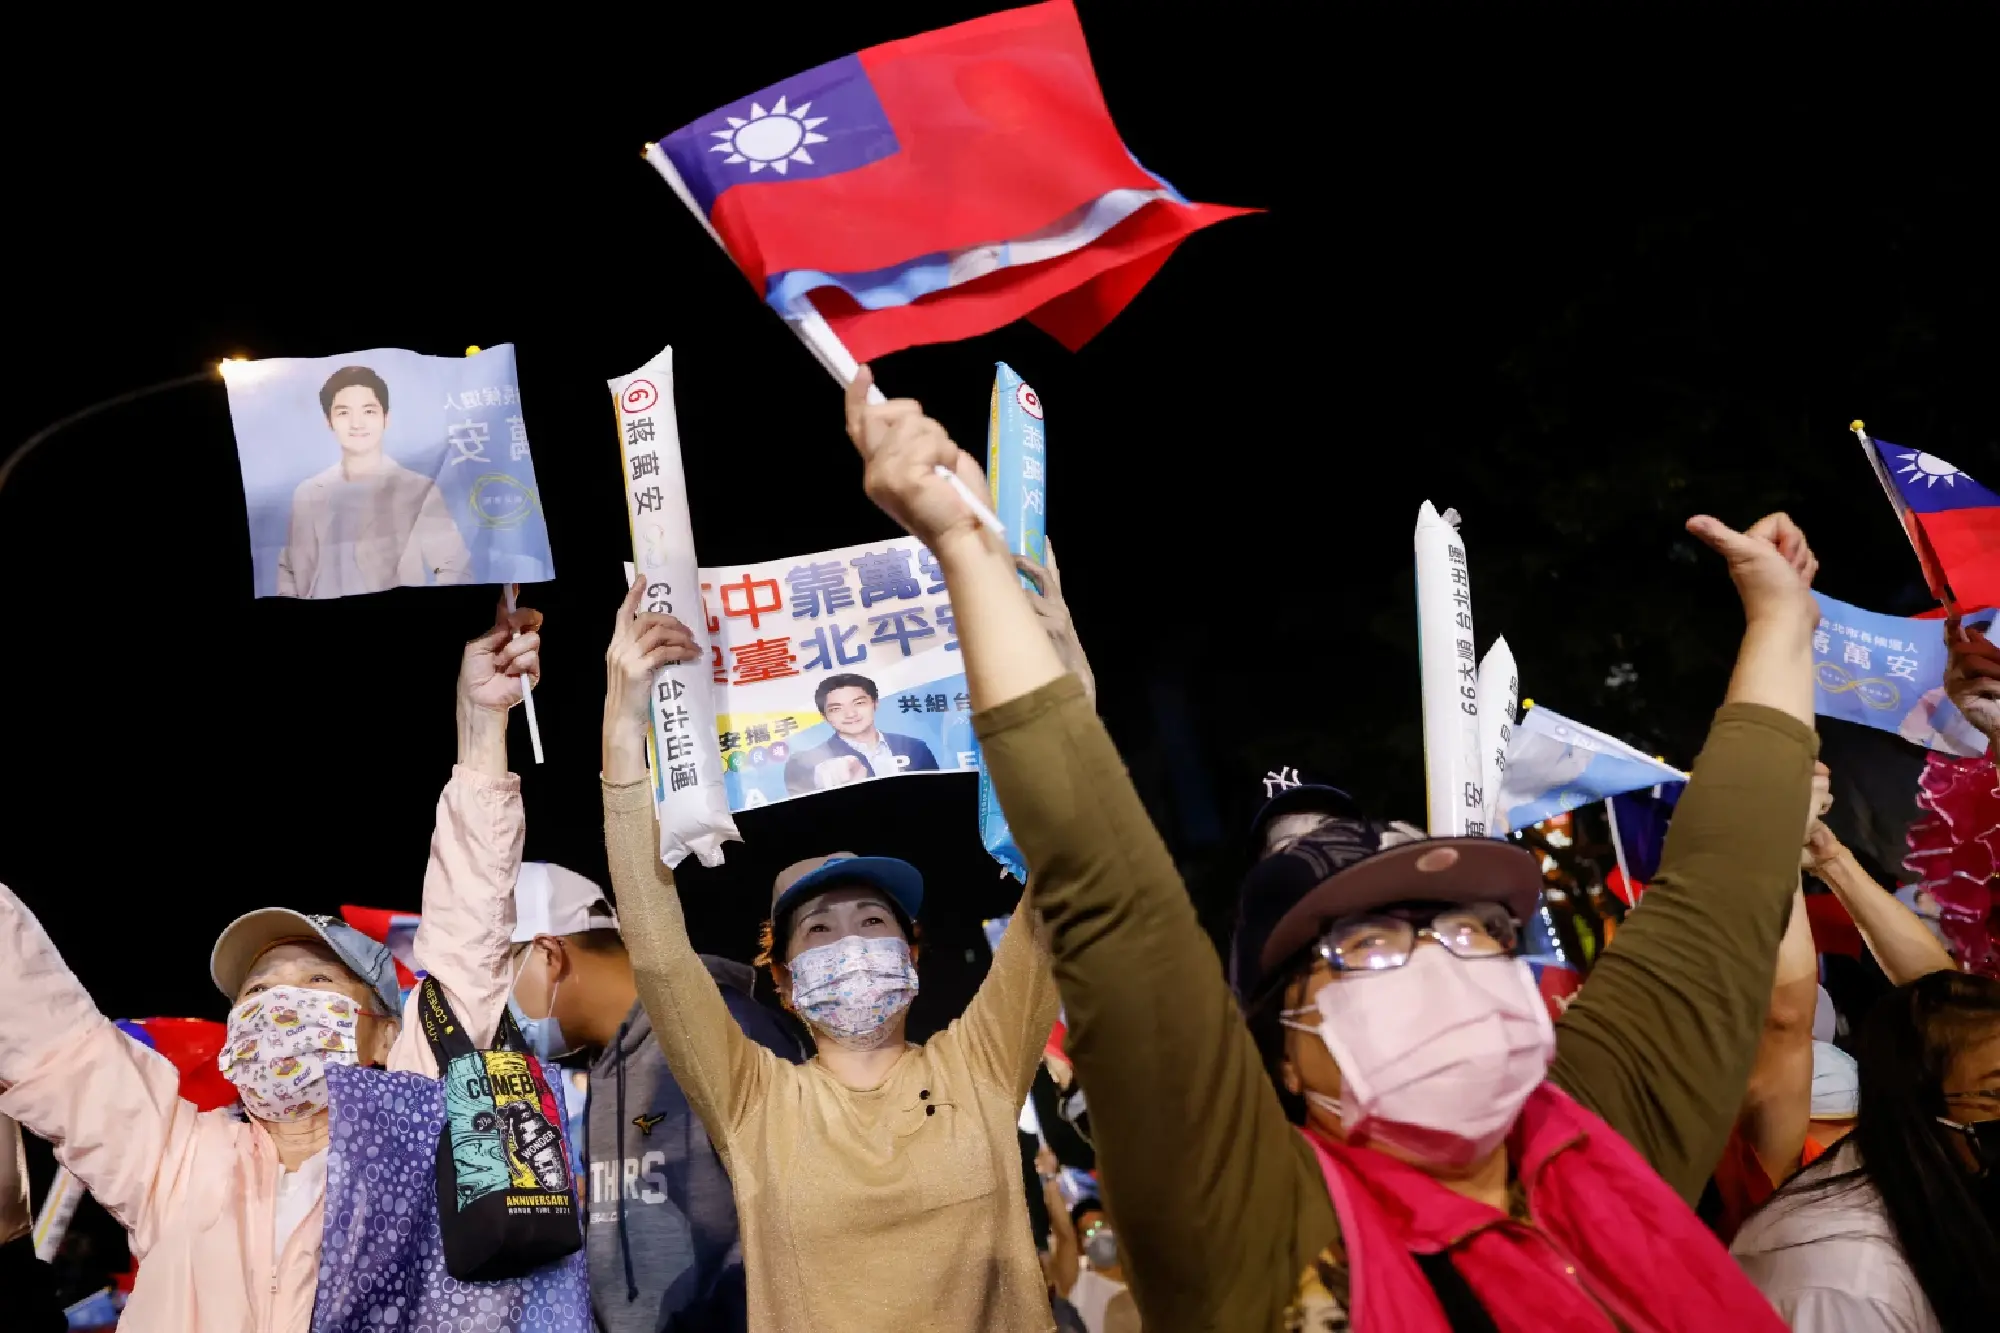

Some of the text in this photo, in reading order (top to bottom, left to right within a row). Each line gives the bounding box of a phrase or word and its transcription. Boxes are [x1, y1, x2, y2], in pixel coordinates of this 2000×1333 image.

[625, 416, 665, 516] 蔣萬安
[1447, 544, 1473, 631] 台北出運
[1456, 637, 1479, 717] 66大順
[657, 679, 699, 792] 台北出運
[521, 1130, 556, 1160] WONDER
[506, 1195, 569, 1206] ANNIVERSARY
